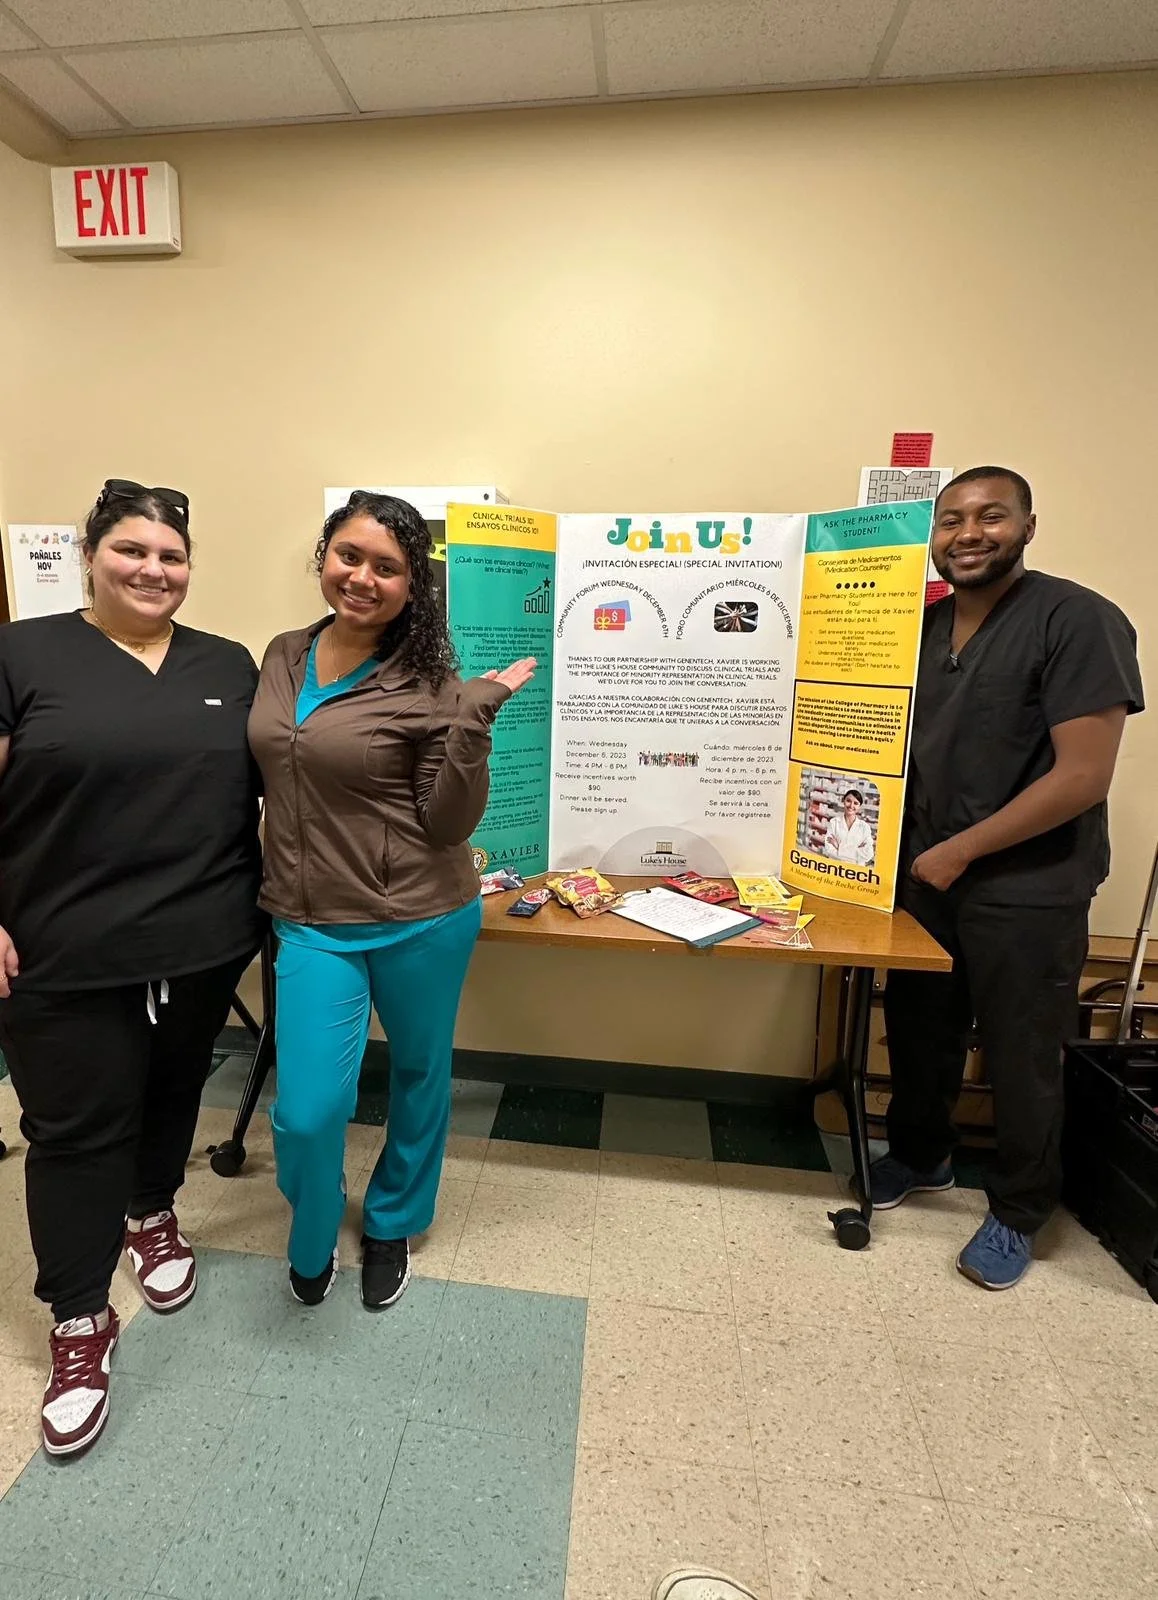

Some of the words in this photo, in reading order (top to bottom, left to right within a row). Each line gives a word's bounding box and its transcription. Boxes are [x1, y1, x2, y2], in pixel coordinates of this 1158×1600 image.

[74, 168, 148, 237] EXIT
[467, 522, 500, 530] ENSAYOS
[505, 515, 526, 523] TRIALS
[824, 520, 840, 528] ASK
[842, 518, 856, 526] THE
[858, 512, 908, 523] PHARMACY
[607, 518, 693, 553] Join
[696, 517, 752, 554] Us!
[843, 526, 880, 538] STUDENT!
[30, 550, 61, 560] PAÑALES
[858, 555, 901, 564] Medicamentos
[38, 562, 52, 570] HOY
[582, 558, 637, 569] ¡INVITACIÓN
[684, 560, 722, 568] (SPECIAL
[557, 596, 577, 638] COMMUNITY
[576, 582, 599, 600] FORUM
[600, 580, 644, 594] WEDNESDAY
[642, 591, 667, 624] DECEMBER
[676, 620, 685, 640] FORO
[682, 582, 724, 619] COMUNITARIO
[726, 579, 766, 593] MIÉRCOLES
[770, 593, 780, 603] DE
[777, 601, 794, 639] DICIEMBRE
[490, 844, 540, 860] XAVIER
[790, 850, 880, 885] Genentech
[824, 876, 834, 886] the
[836, 880, 855, 890] Roche
[857, 884, 879, 895] Group
